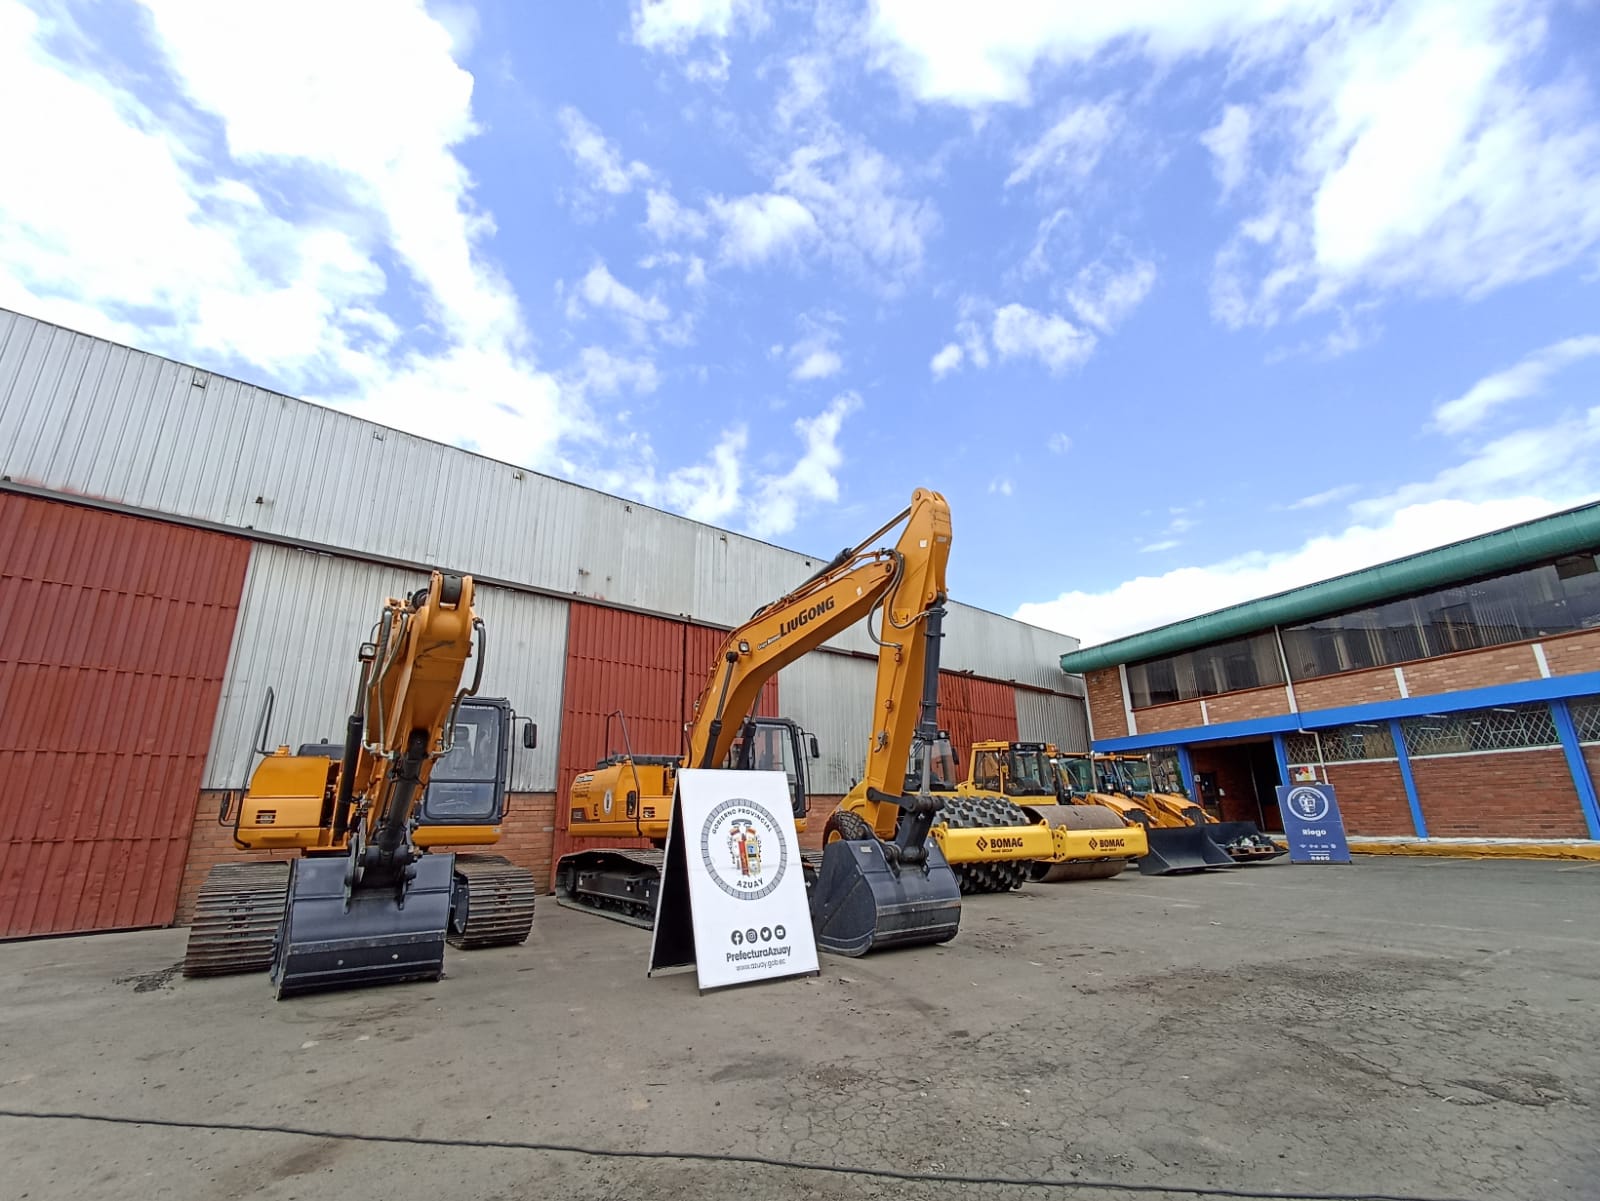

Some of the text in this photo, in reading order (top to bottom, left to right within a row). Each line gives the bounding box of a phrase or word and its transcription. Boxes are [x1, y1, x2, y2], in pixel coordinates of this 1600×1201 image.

[712, 808, 773, 835] GOBIERNO PROVINCIAL
[990, 837, 1023, 848] BOMAG
[1099, 838, 1125, 848] BOMAG
[736, 877, 764, 889] AZUAY
[726, 945, 791, 963] PrefecturaAzuay
